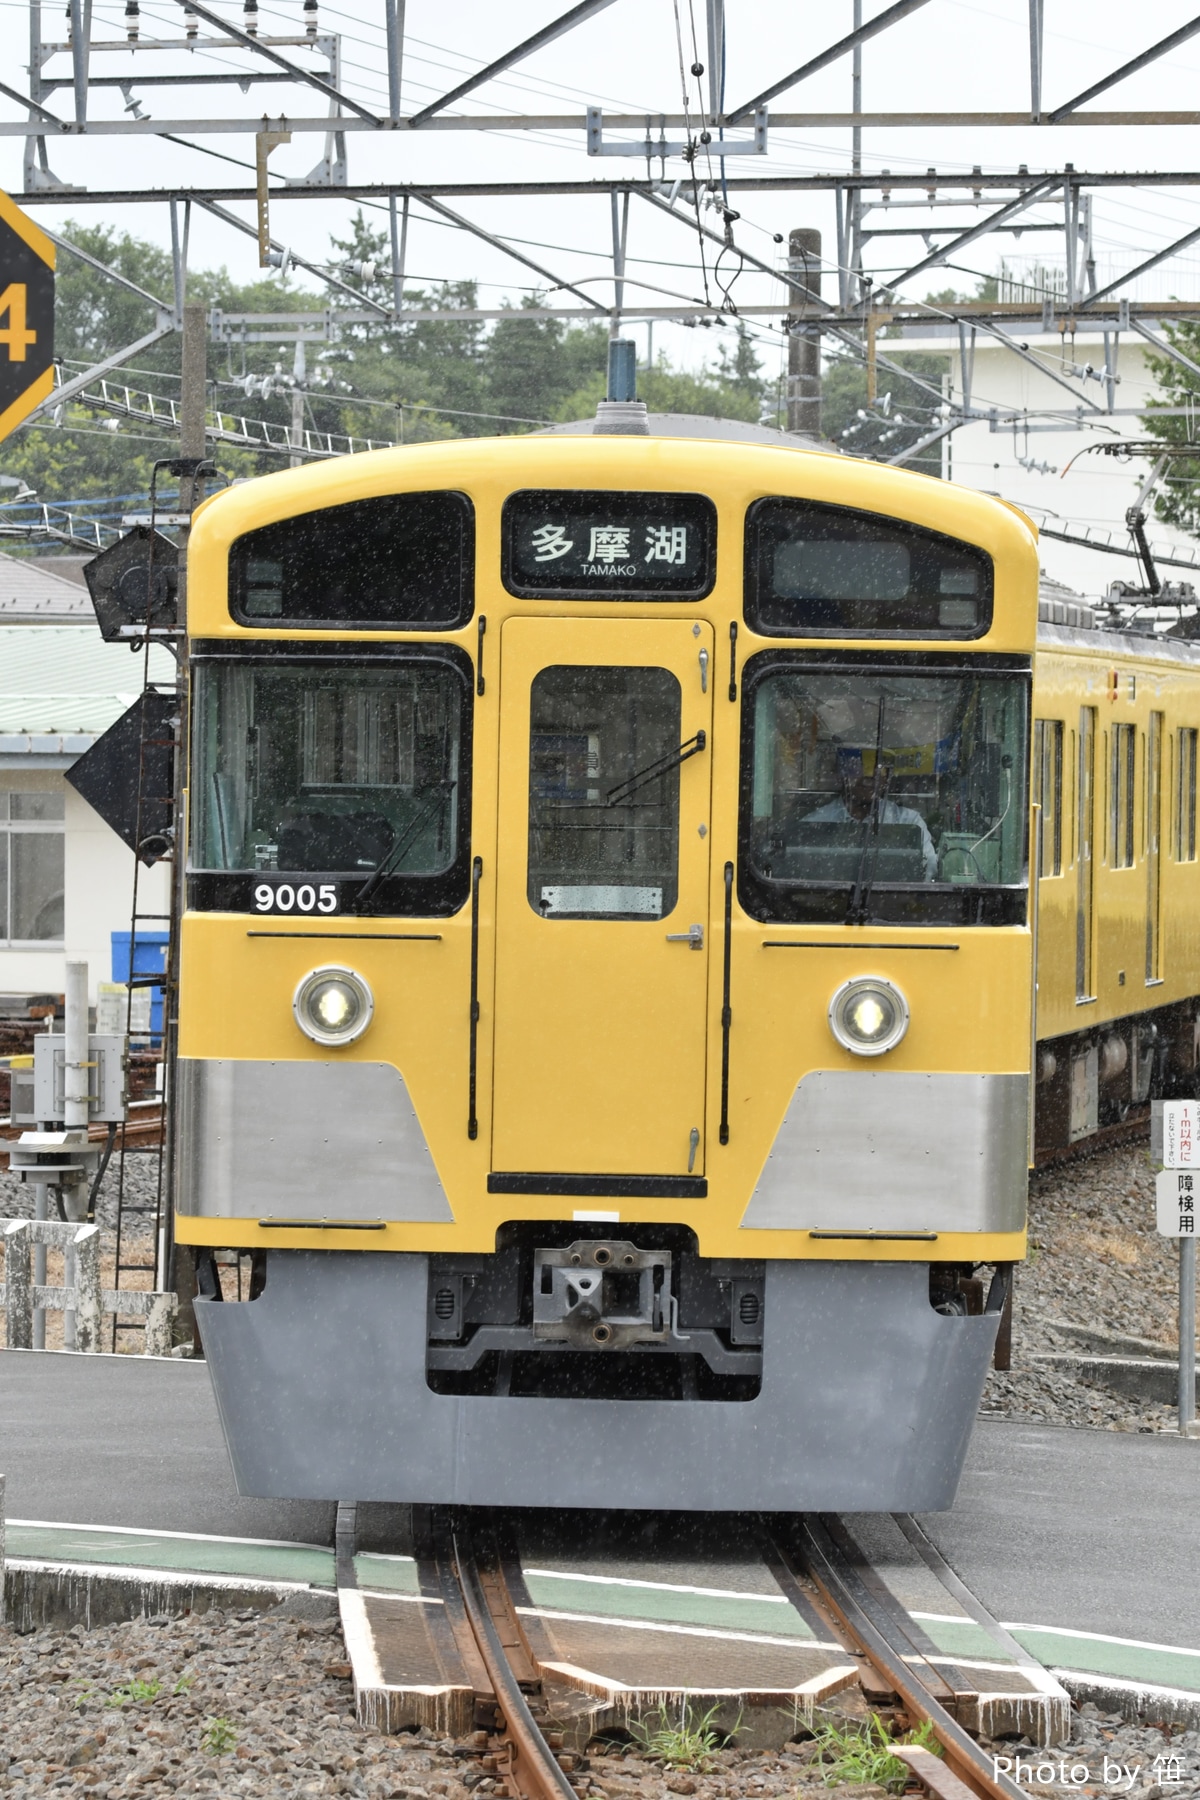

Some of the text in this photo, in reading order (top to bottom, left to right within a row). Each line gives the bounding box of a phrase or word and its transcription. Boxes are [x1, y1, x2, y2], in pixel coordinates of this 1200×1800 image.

[0, 283, 37, 362] 4
[531, 523, 687, 565] 多摩湖
[581, 564, 637, 576] TAMAKO
[254, 884, 338, 913] 9005
[1178, 1174, 1194, 1233] 障検用
